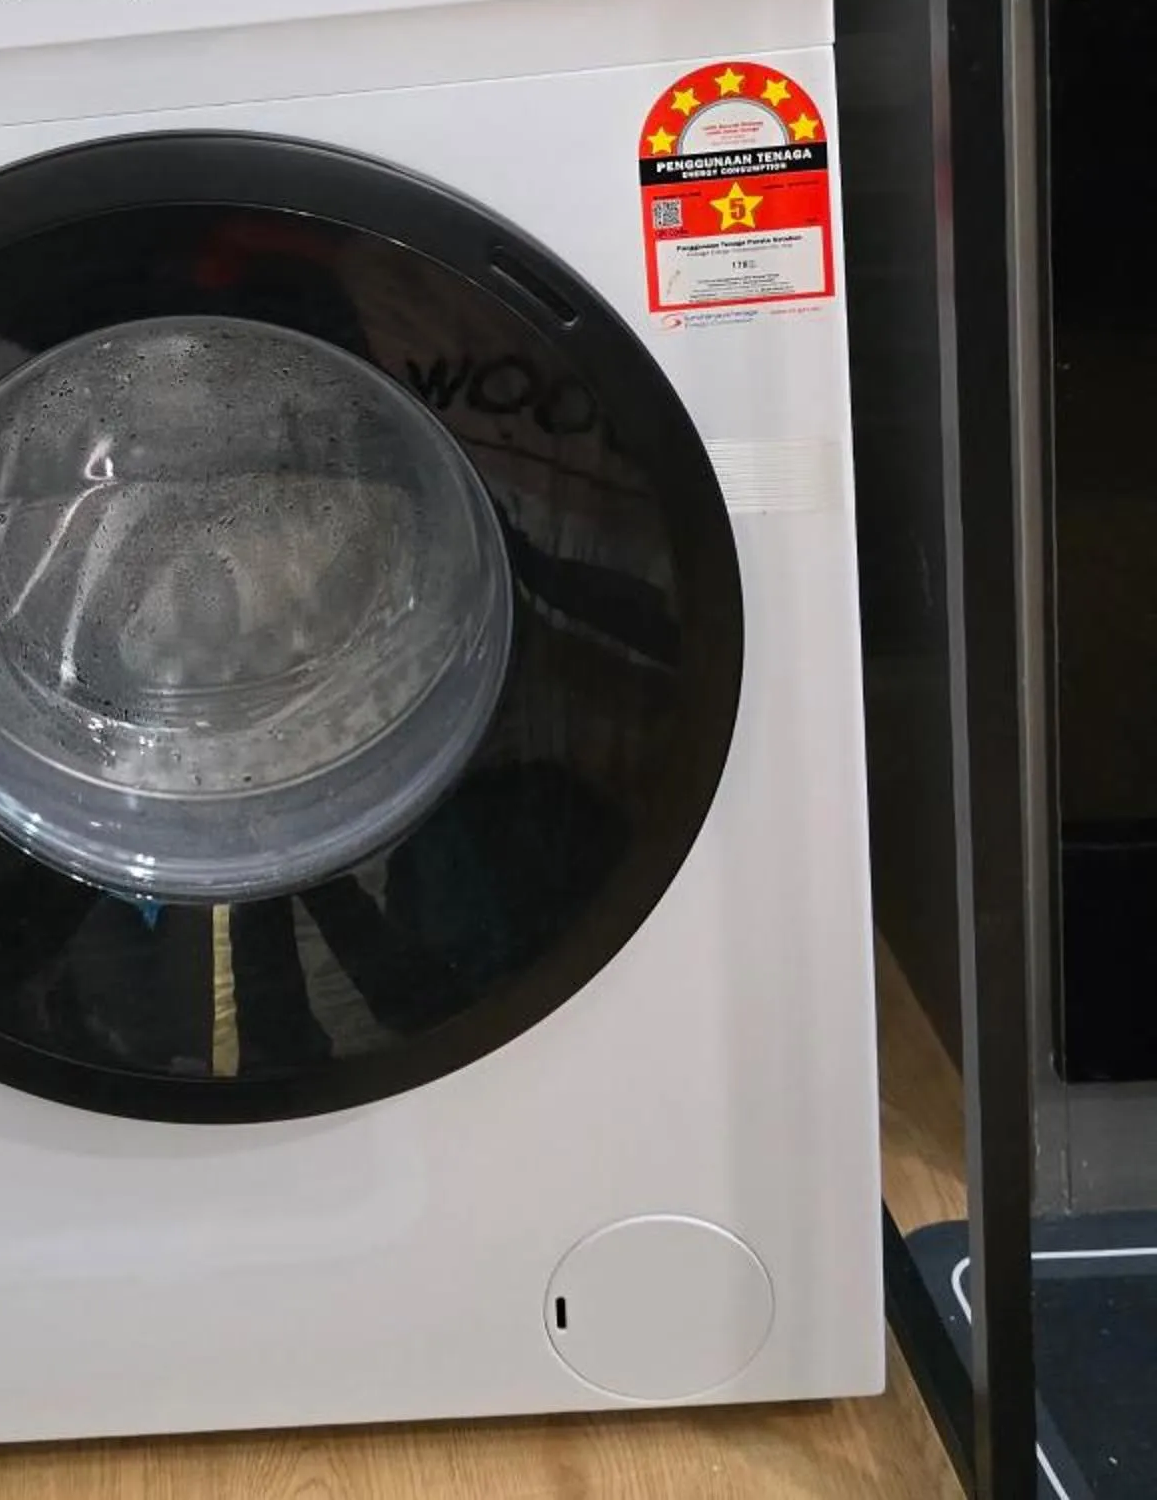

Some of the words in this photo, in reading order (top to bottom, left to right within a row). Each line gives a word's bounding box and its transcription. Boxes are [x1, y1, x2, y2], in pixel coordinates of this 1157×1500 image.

[656, 154, 752, 173] PENGGUNAAN
[757, 148, 812, 164] TENAGA
[728, 198, 746, 220] 5
